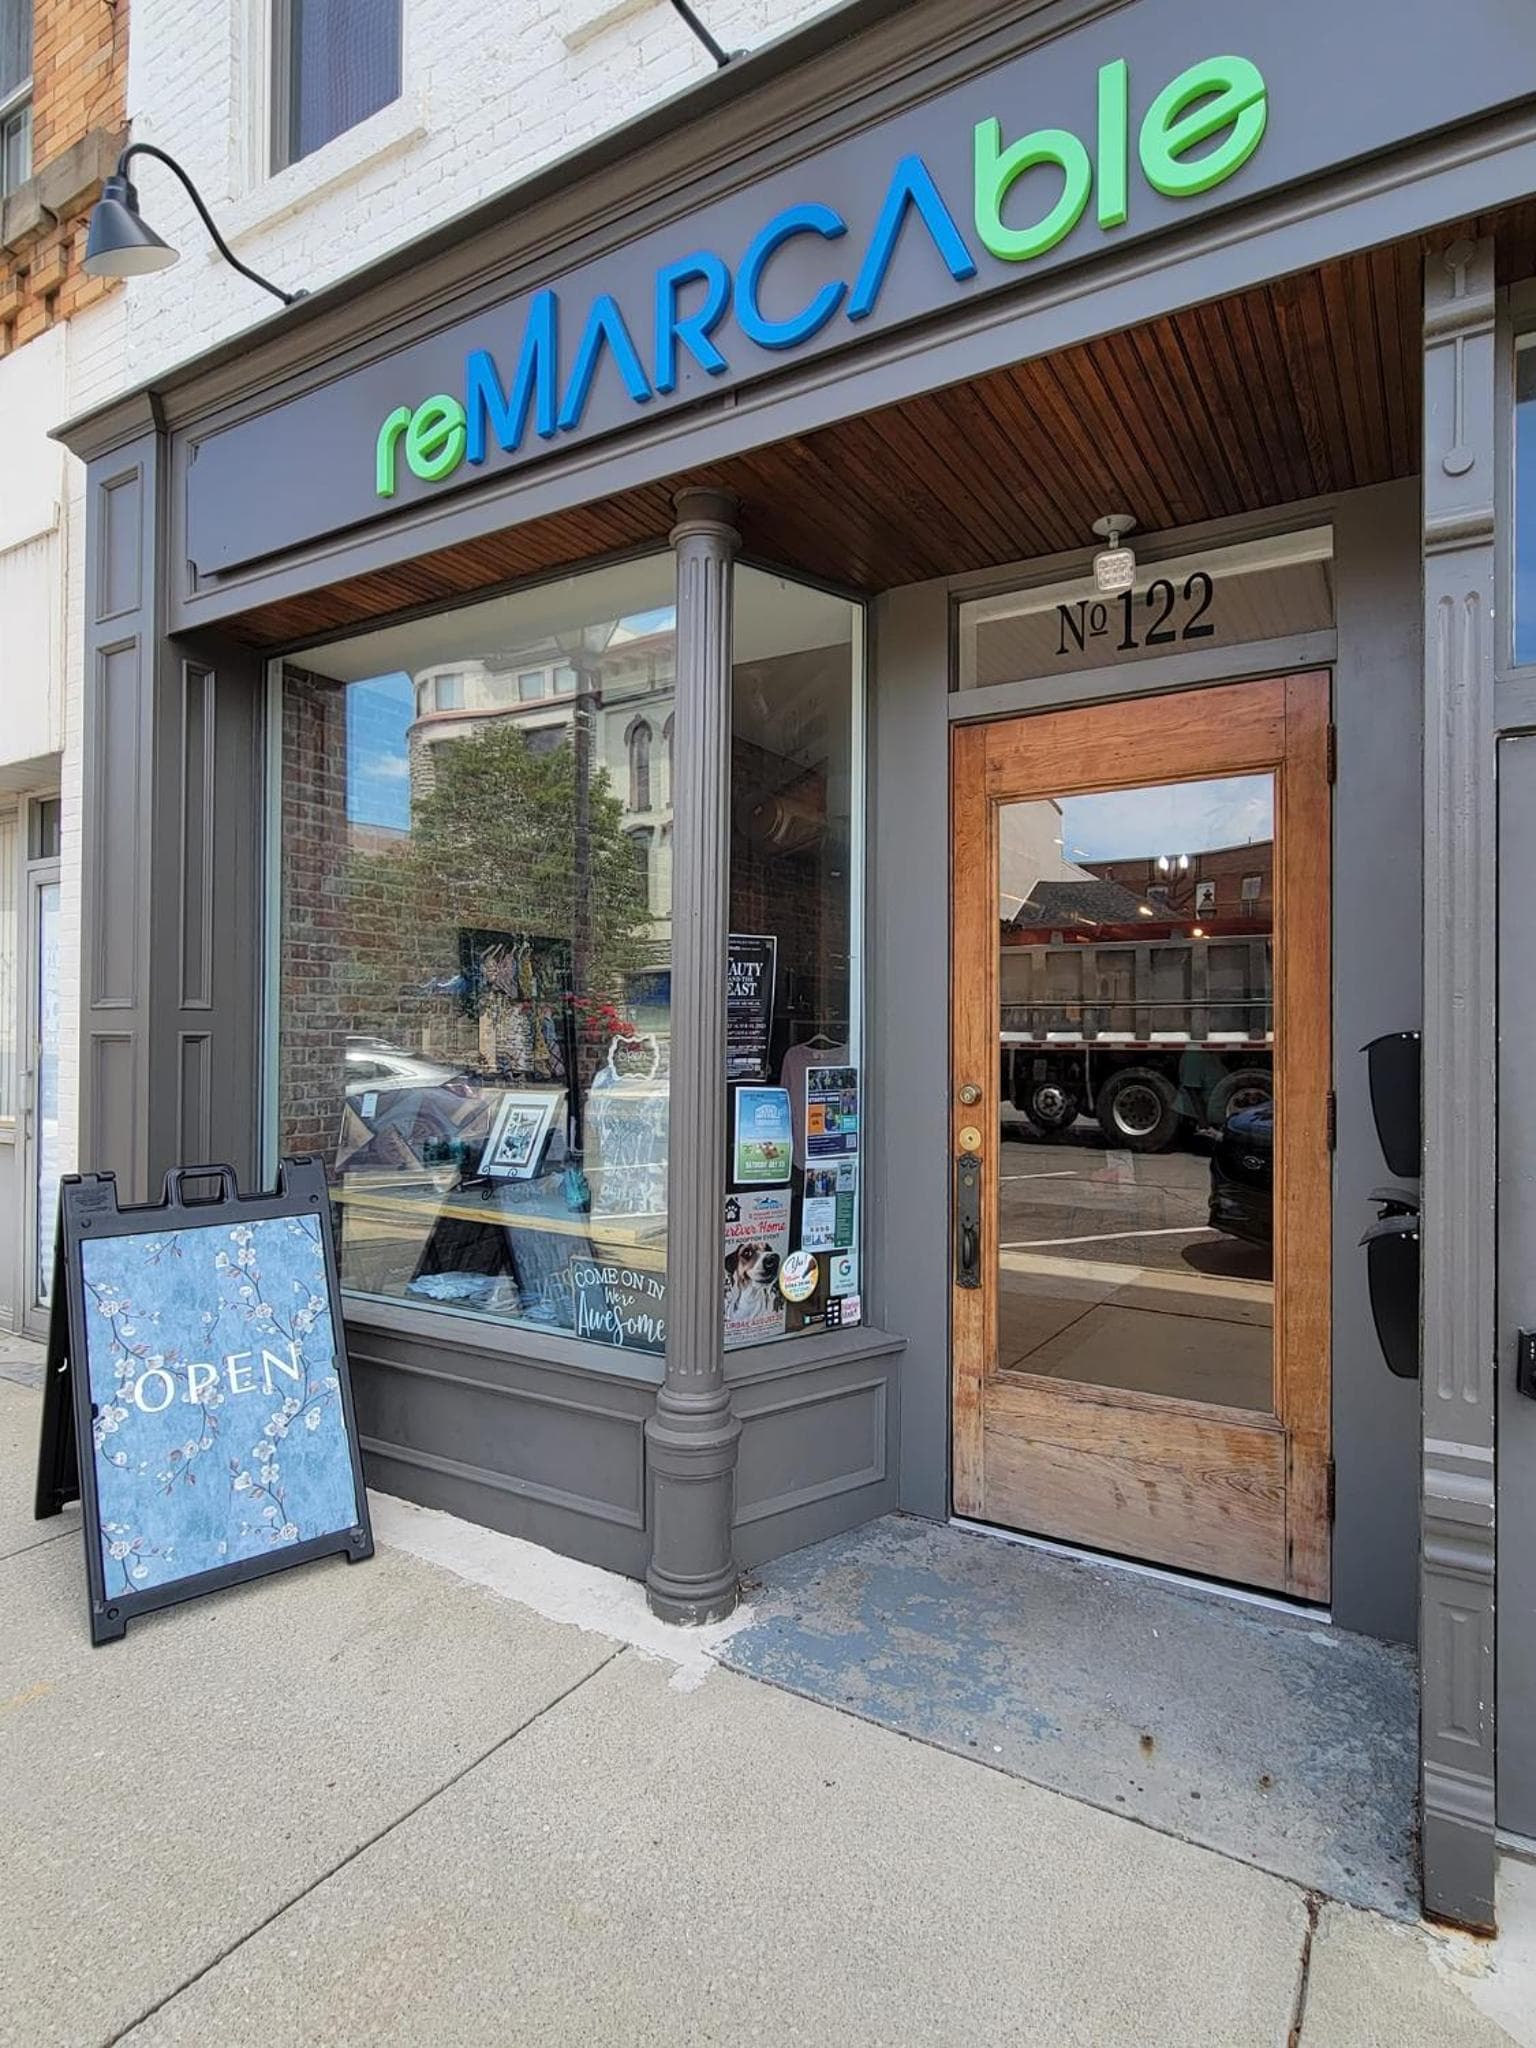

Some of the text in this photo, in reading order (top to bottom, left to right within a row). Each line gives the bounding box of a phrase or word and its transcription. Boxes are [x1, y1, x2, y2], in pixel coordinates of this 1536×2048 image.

[375, 54, 1267, 499] reMARCAble
[1117, 572, 1215, 650] 122
[728, 962, 763, 976] AUTY
[728, 982, 757, 996] EAST
[838, 1259, 852, 1276] G
[575, 1266, 666, 1301] COME ON IN
[604, 1286, 636, 1307] We're
[134, 1341, 301, 1413] OPEN
